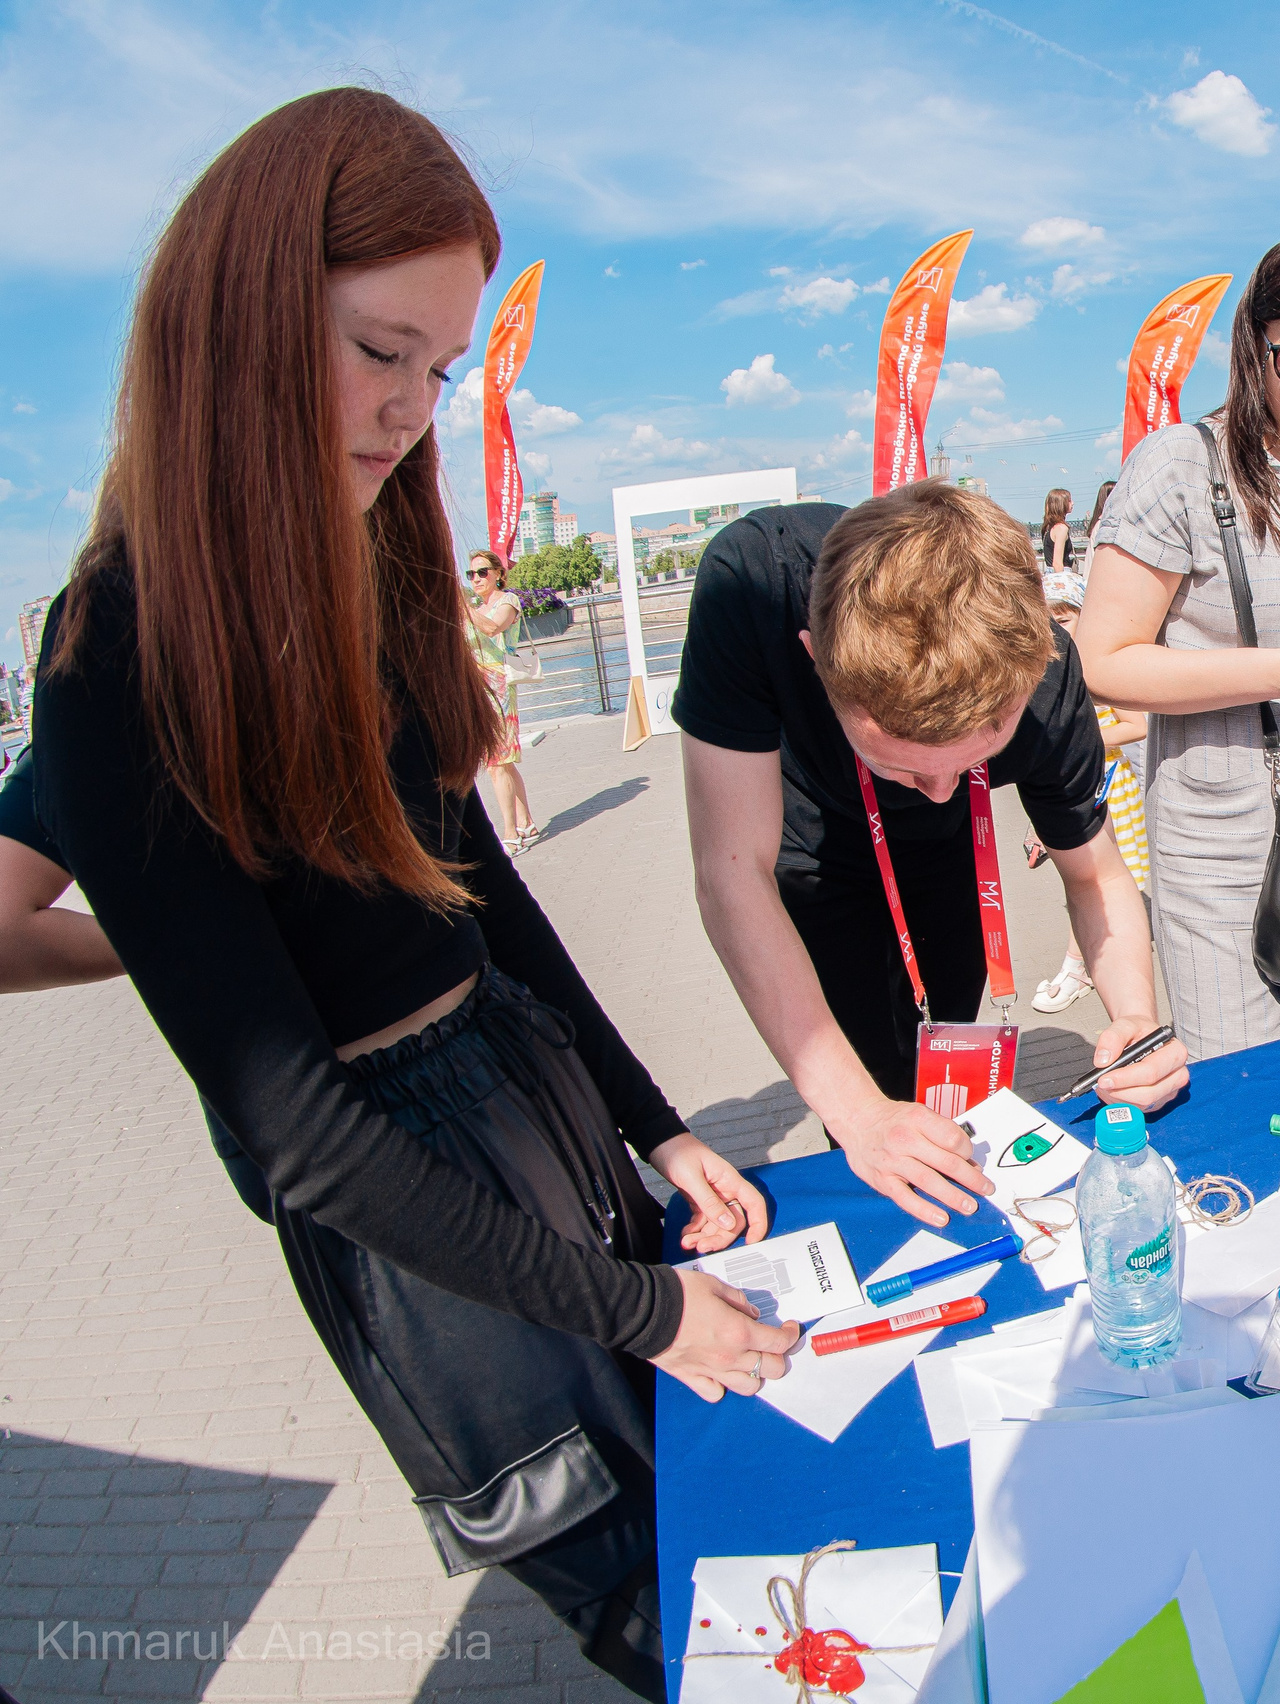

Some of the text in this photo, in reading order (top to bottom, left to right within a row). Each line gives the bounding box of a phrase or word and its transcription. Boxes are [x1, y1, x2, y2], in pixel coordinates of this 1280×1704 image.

[505, 342, 517, 383] Думе
[1146, 371, 1158, 422] палата
[1152, 345, 1166, 370] при
[1164, 335, 1184, 371] Думе
[889, 403, 906, 492] Молодёжная
[903, 315, 914, 342] при
[905, 417, 919, 488] ябинской
[915, 302, 930, 342] Думе
[1158, 370, 1172, 430] ородской
[497, 447, 511, 544] Молодёжная
[806, 1239, 834, 1293] ЧЕЛЯБИНСК
